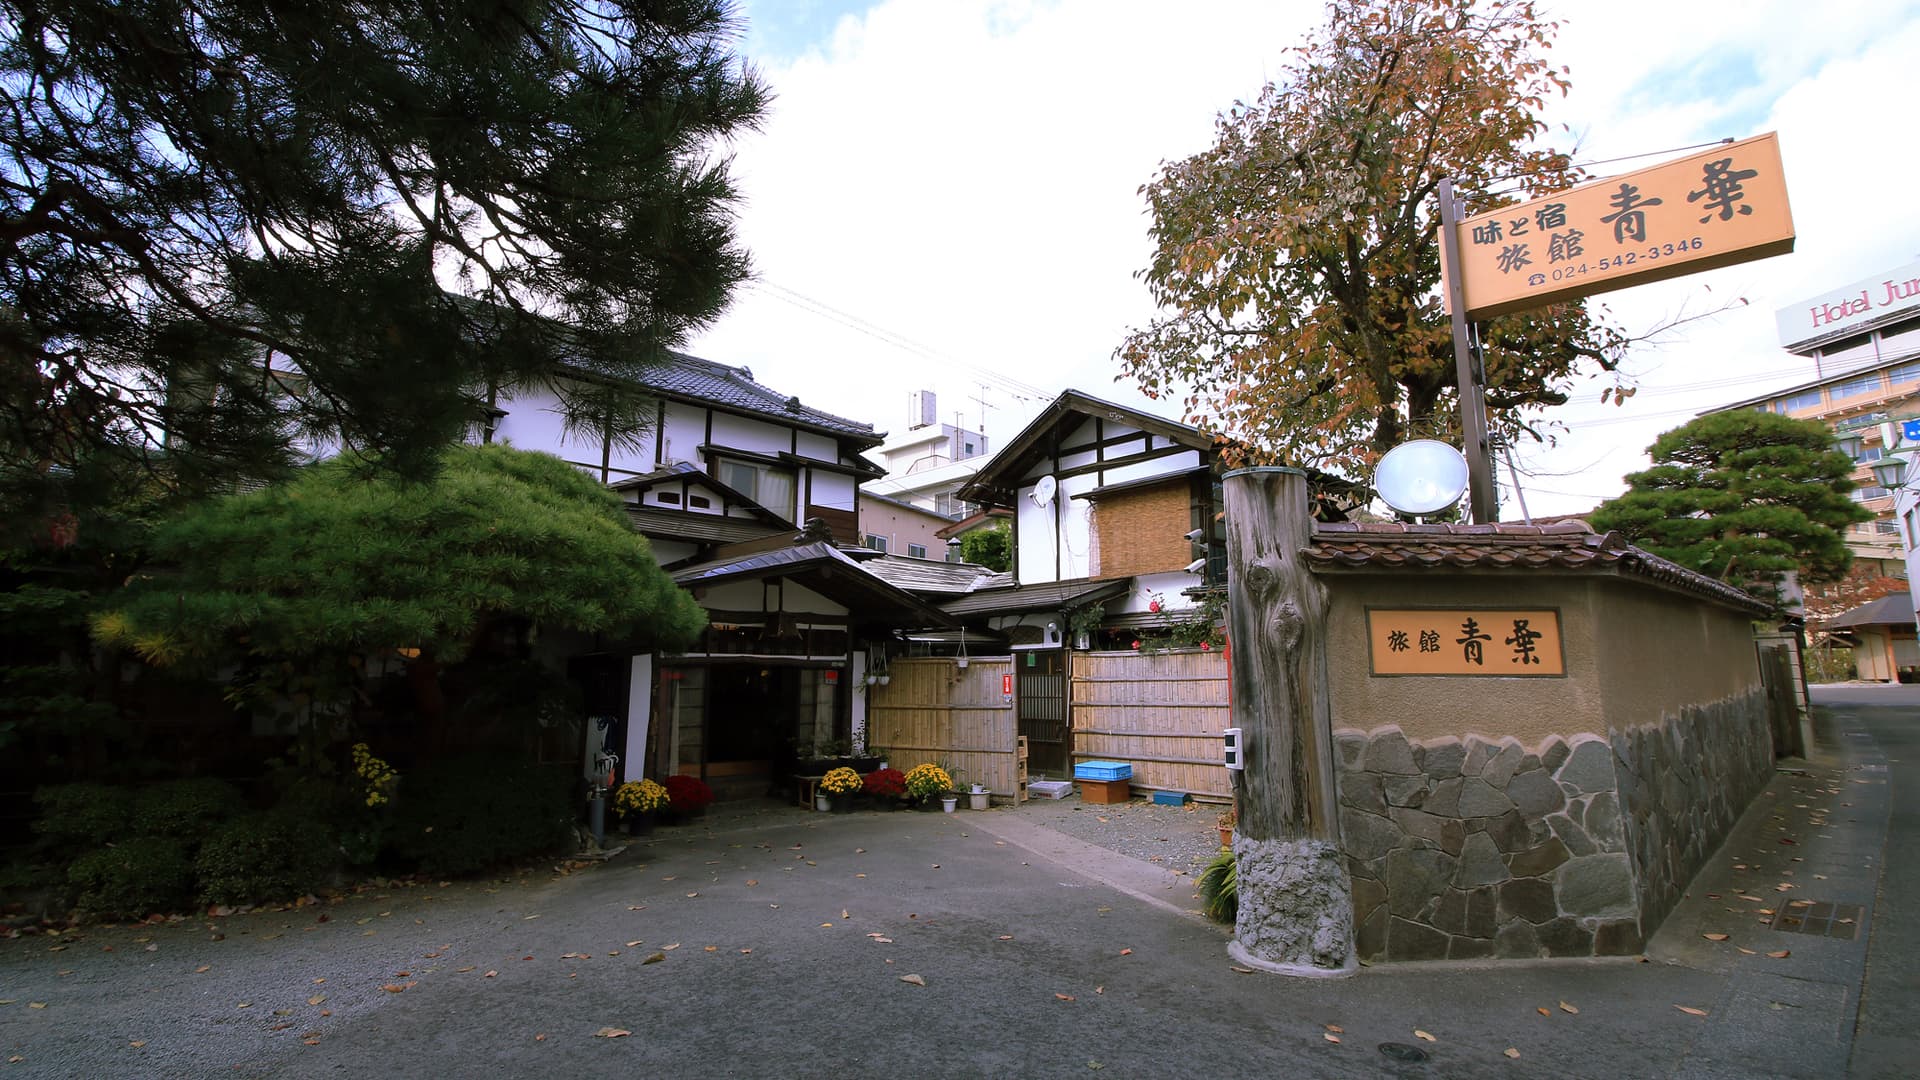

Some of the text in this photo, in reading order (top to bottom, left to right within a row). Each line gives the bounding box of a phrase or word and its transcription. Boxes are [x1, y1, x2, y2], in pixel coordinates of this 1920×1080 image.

[1600, 158, 1758, 244] 青葉
[1472, 203, 1566, 245] 味と宿
[1496, 229, 1584, 274] 旅館
[1552, 237, 1703, 281] 024-542-3346
[1810, 290, 1872, 328] Hotel
